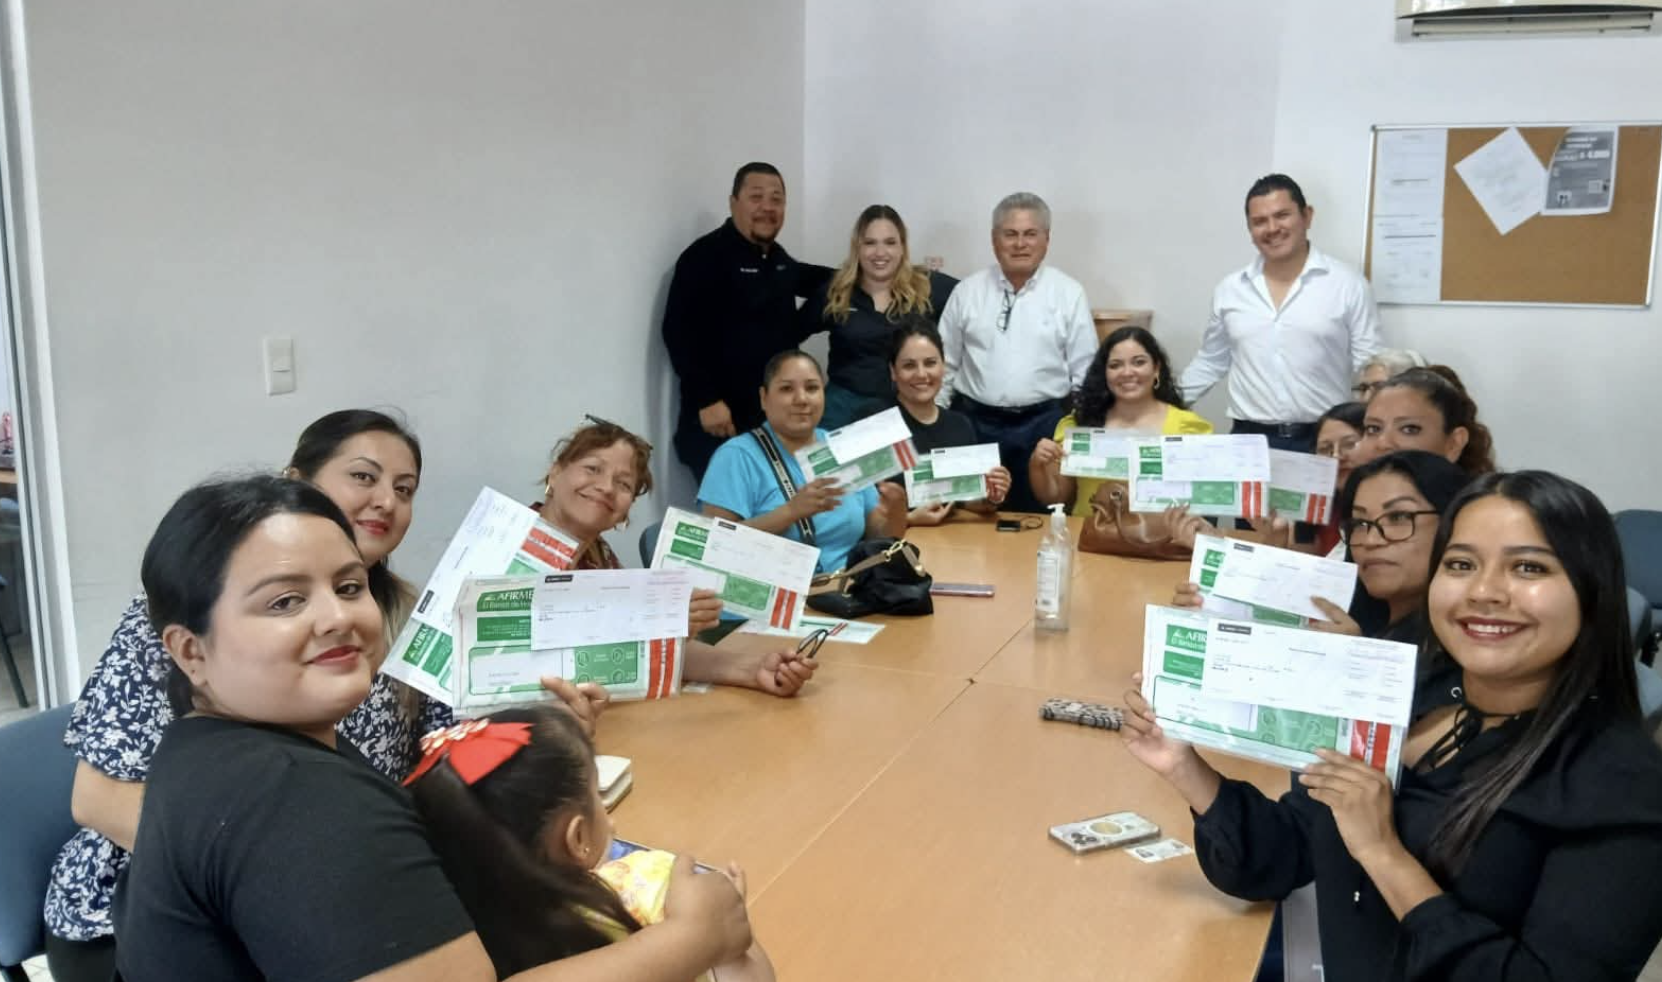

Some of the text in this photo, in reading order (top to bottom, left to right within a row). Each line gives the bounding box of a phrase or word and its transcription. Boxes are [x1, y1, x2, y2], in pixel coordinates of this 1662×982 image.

[497, 589, 534, 601] AFIRME
[413, 627, 429, 649] AFIR
[1185, 630, 1207, 643] AFIR
